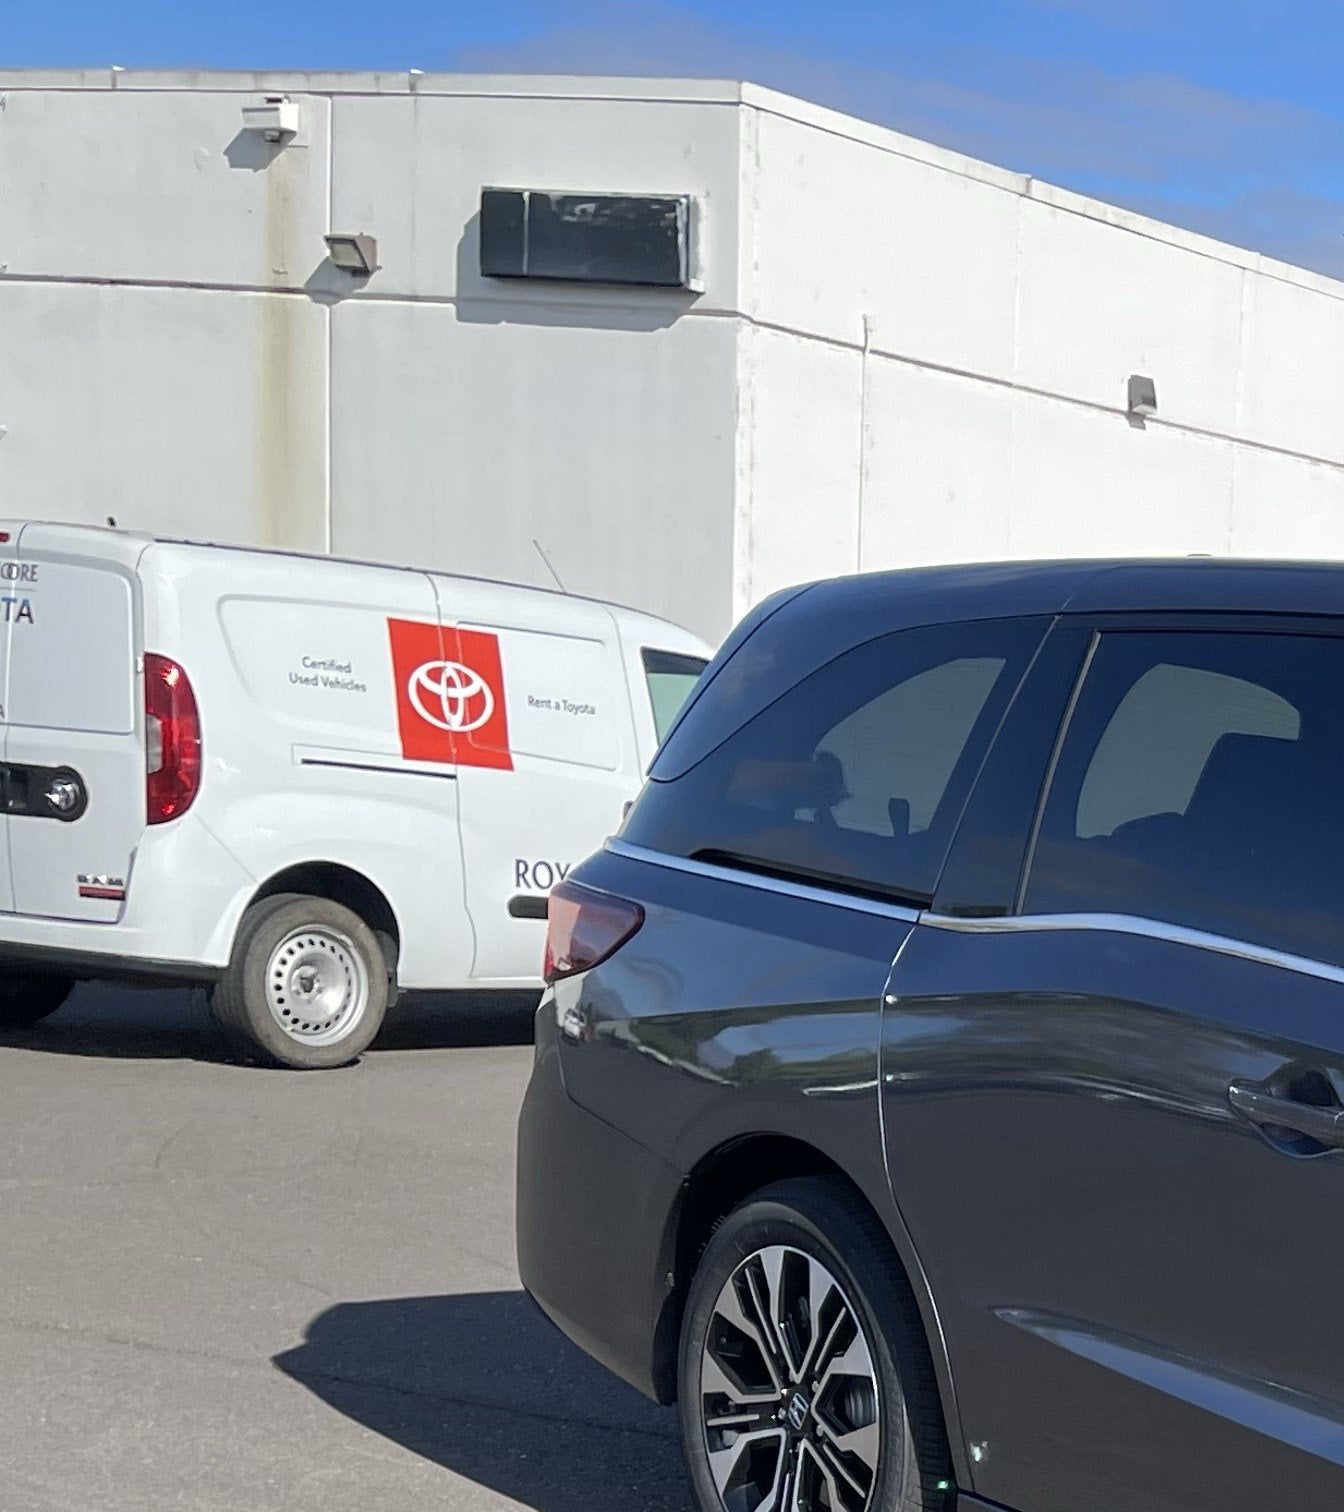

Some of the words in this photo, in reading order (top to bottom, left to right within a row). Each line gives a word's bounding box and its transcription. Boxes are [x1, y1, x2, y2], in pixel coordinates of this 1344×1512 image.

[302, 656, 352, 674] Certified
[289, 671, 318, 687] Used
[320, 675, 367, 693] Vehicles
[527, 695, 552, 710] Rent
[554, 701, 561, 711] a
[561, 699, 596, 716] Toyota
